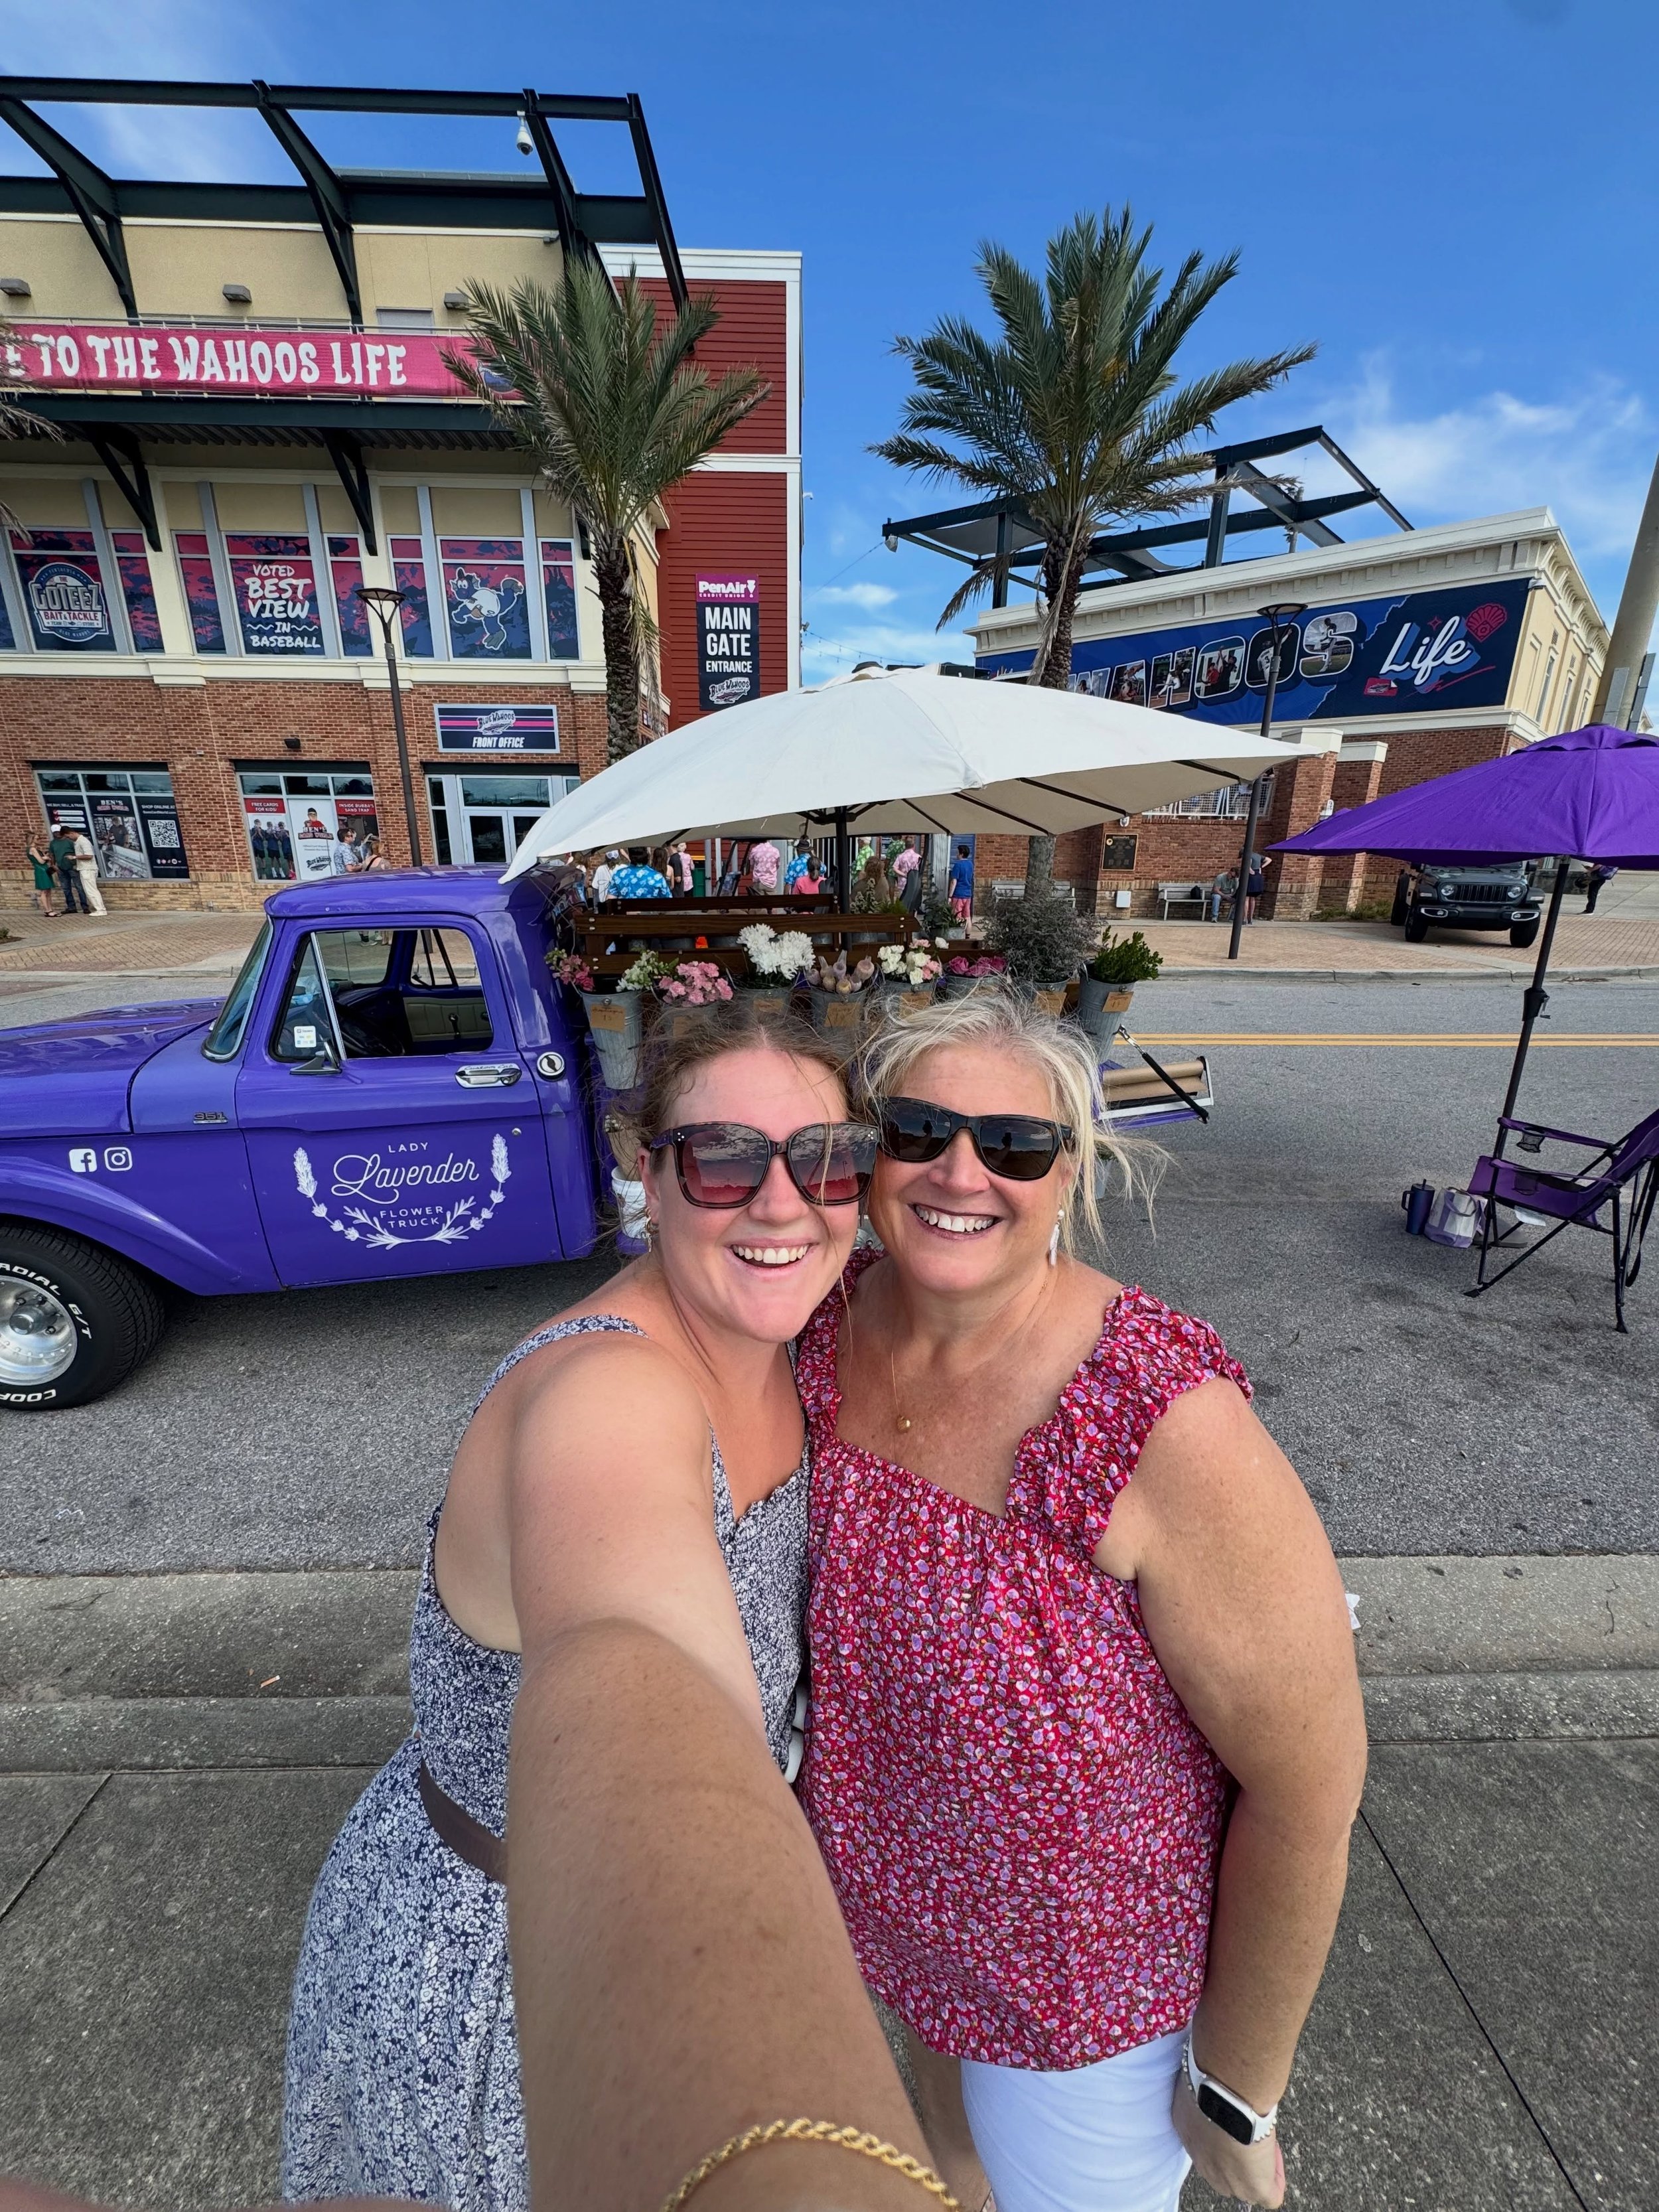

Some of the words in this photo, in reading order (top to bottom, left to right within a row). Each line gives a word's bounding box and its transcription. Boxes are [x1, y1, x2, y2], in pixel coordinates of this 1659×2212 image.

[31, 334, 80, 378] TO
[86, 335, 161, 380] THE
[168, 336, 321, 384] WAHOOS
[330, 342, 406, 386] LIFE
[252, 564, 295, 577] VOTED
[244, 577, 312, 600] BEST
[699, 581, 747, 593] PenAir
[31, 583, 102, 611] GOTEEZ
[44, 611, 63, 621] BAIT
[68, 612, 99, 621] TACKLE
[248, 599, 310, 619] VIEW
[705, 607, 751, 630] MAIN
[275, 621, 291, 633] IN
[250, 635, 321, 648] BASEBALL
[706, 633, 751, 656] GATE
[1379, 615, 1472, 686] Life
[705, 661, 753, 673] ENTRANCE
[710, 683, 726, 696] BLUE
[725, 679, 749, 691] WAHOOS
[478, 717, 492, 729] BLUE
[492, 712, 515, 721] WAHOOS
[472, 737, 498, 748] FRONT
[498, 737, 525, 748] OFFICE
[194, 1112, 226, 1120] 351
[388, 1142, 429, 1153] LADY
[331, 1153, 479, 1204] Lavender
[380, 1206, 444, 1218] FLOWER
[388, 1217, 441, 1228] TRUCK
[68, 1303, 92, 1339] G/T
